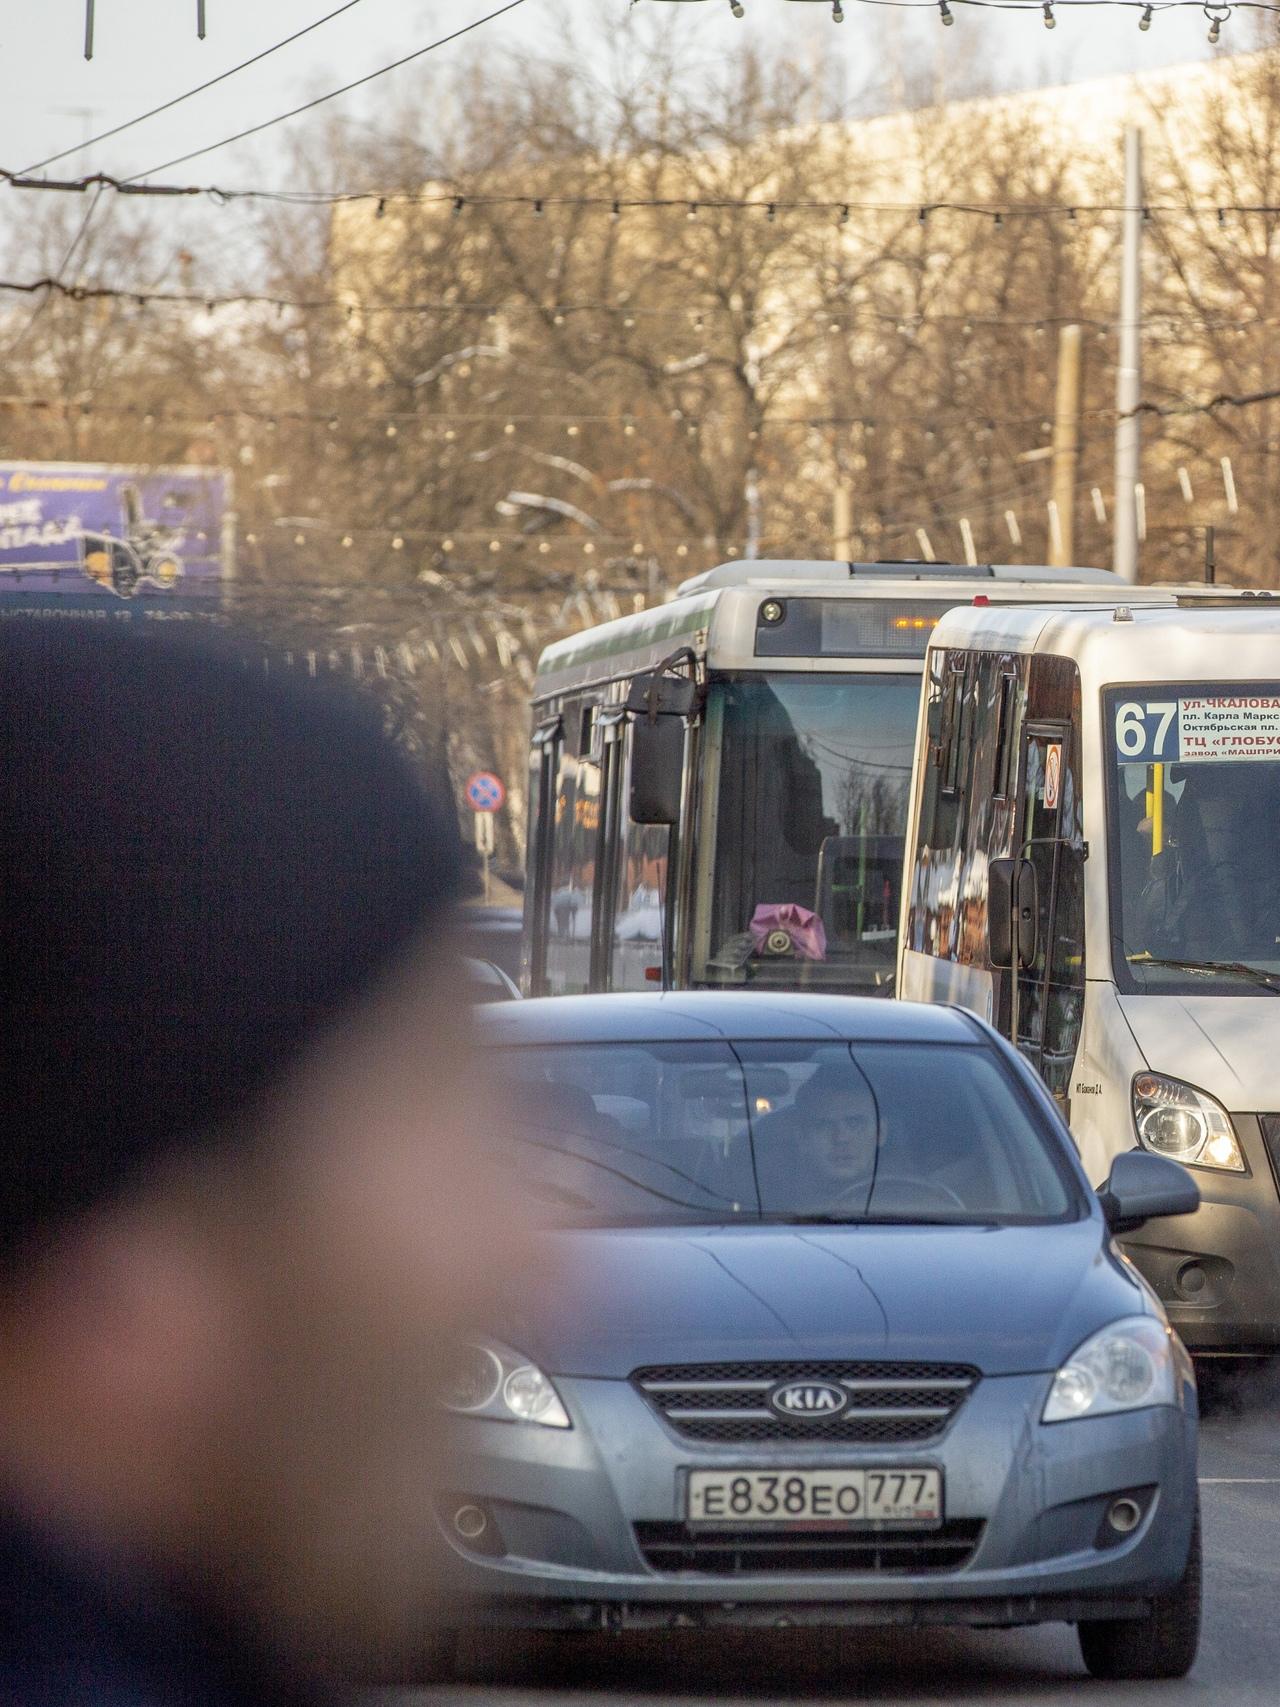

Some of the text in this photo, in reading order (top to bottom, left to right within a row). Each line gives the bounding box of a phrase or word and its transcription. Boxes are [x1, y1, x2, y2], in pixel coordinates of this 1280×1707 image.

[1183, 698, 1280, 711] ул.ЧКАЛОВА
[1204, 712, 1240, 721] Карла
[1115, 702, 1177, 757] 67
[1183, 723, 1257, 733] Октябрьская
[1183, 737, 1206, 748] ТЦ
[784, 1389, 836, 1409] KIA
[703, 1474, 927, 1515] Е838ЕО 777
